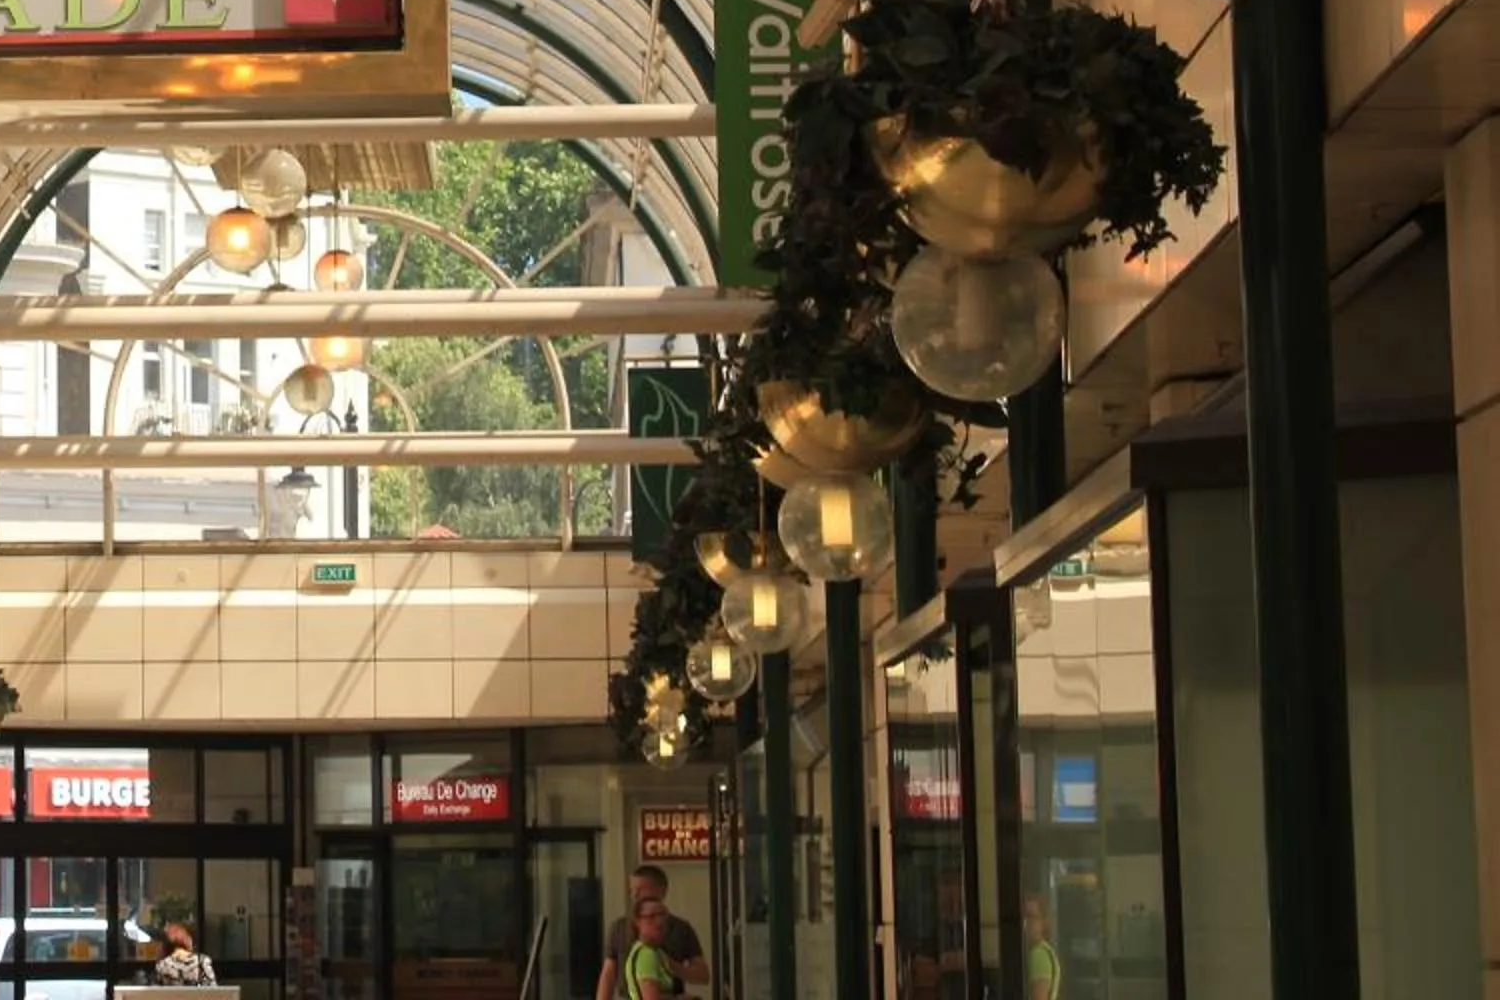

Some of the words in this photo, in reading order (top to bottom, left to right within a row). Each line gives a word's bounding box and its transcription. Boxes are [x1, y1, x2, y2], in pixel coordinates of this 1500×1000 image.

[316, 566, 353, 579] EXIT
[52, 776, 150, 807] BURGE
[437, 780, 453, 800] De
[455, 779, 498, 804] Change
[644, 812, 709, 831] BUREA
[645, 838, 710, 857] CHANG
